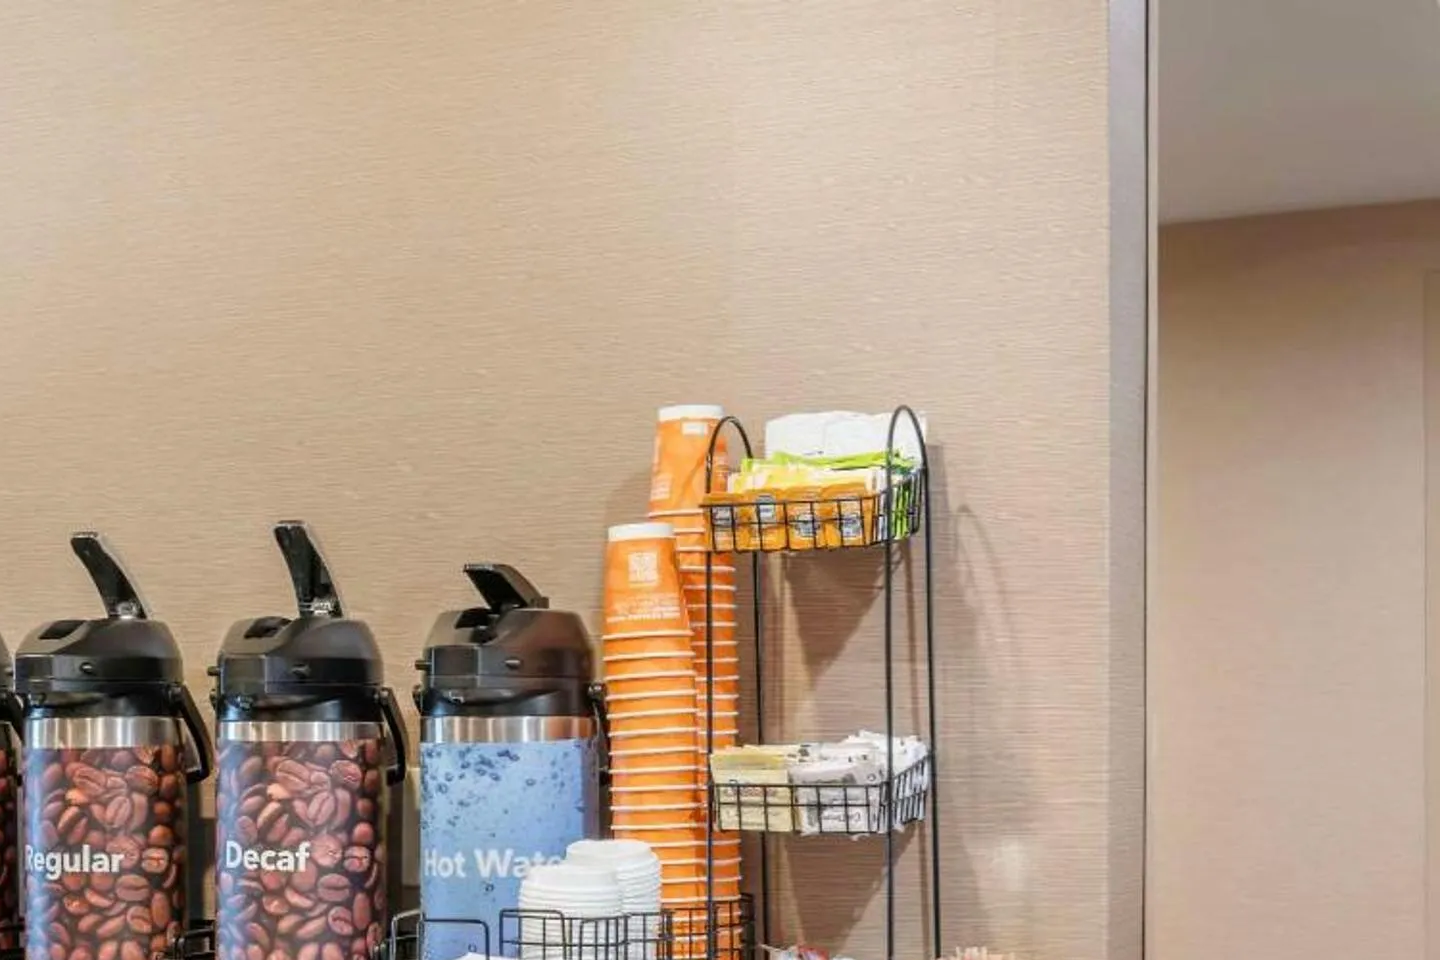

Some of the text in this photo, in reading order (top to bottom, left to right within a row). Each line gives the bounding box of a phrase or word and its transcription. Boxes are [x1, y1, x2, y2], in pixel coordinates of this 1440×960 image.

[25, 844, 124, 880] Regular
[226, 840, 311, 872] Decaf
[424, 848, 466, 878] Hot
